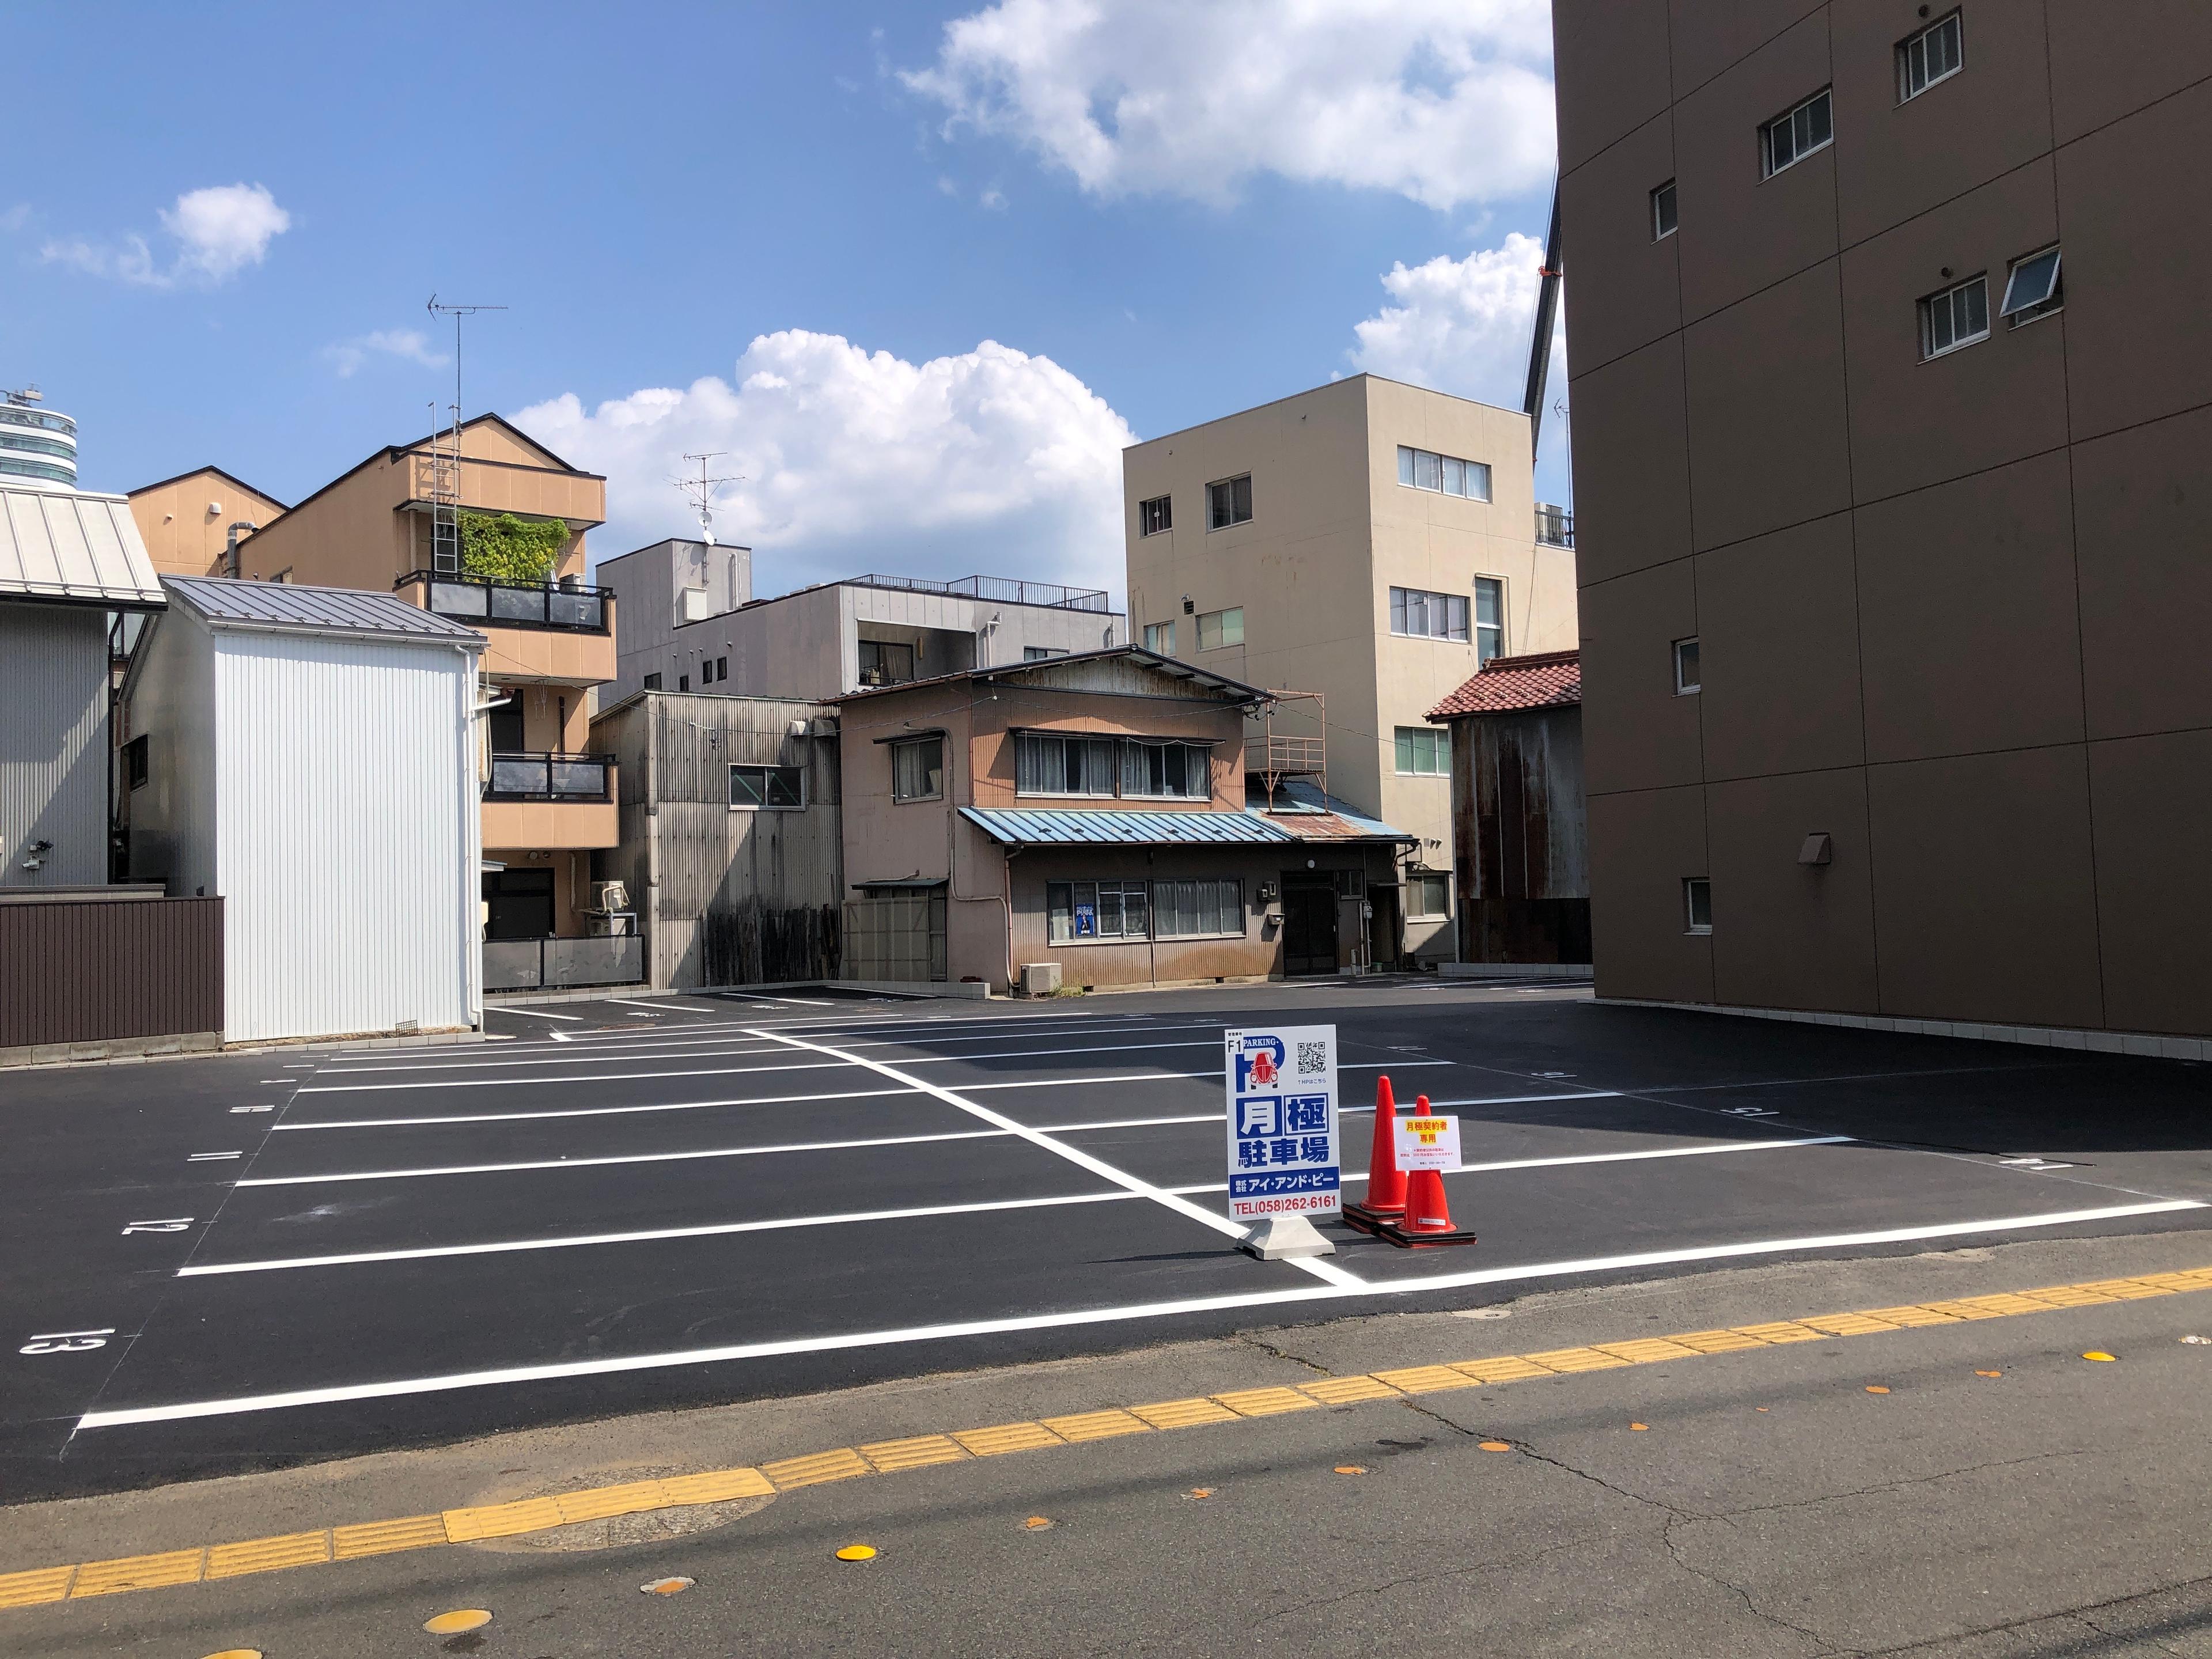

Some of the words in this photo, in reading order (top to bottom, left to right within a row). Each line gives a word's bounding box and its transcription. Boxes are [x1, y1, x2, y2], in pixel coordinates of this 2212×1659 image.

[1228, 1040, 1241, 1053] F1
[1240, 1097, 1327, 1136] 月極
[1407, 1121, 1448, 1131] 月極契約者
[1420, 1134, 1436, 1143] 専用
[1238, 1136, 1330, 1168] 駐車場
[1234, 1195, 1336, 1215] TEL(058)262-6161
